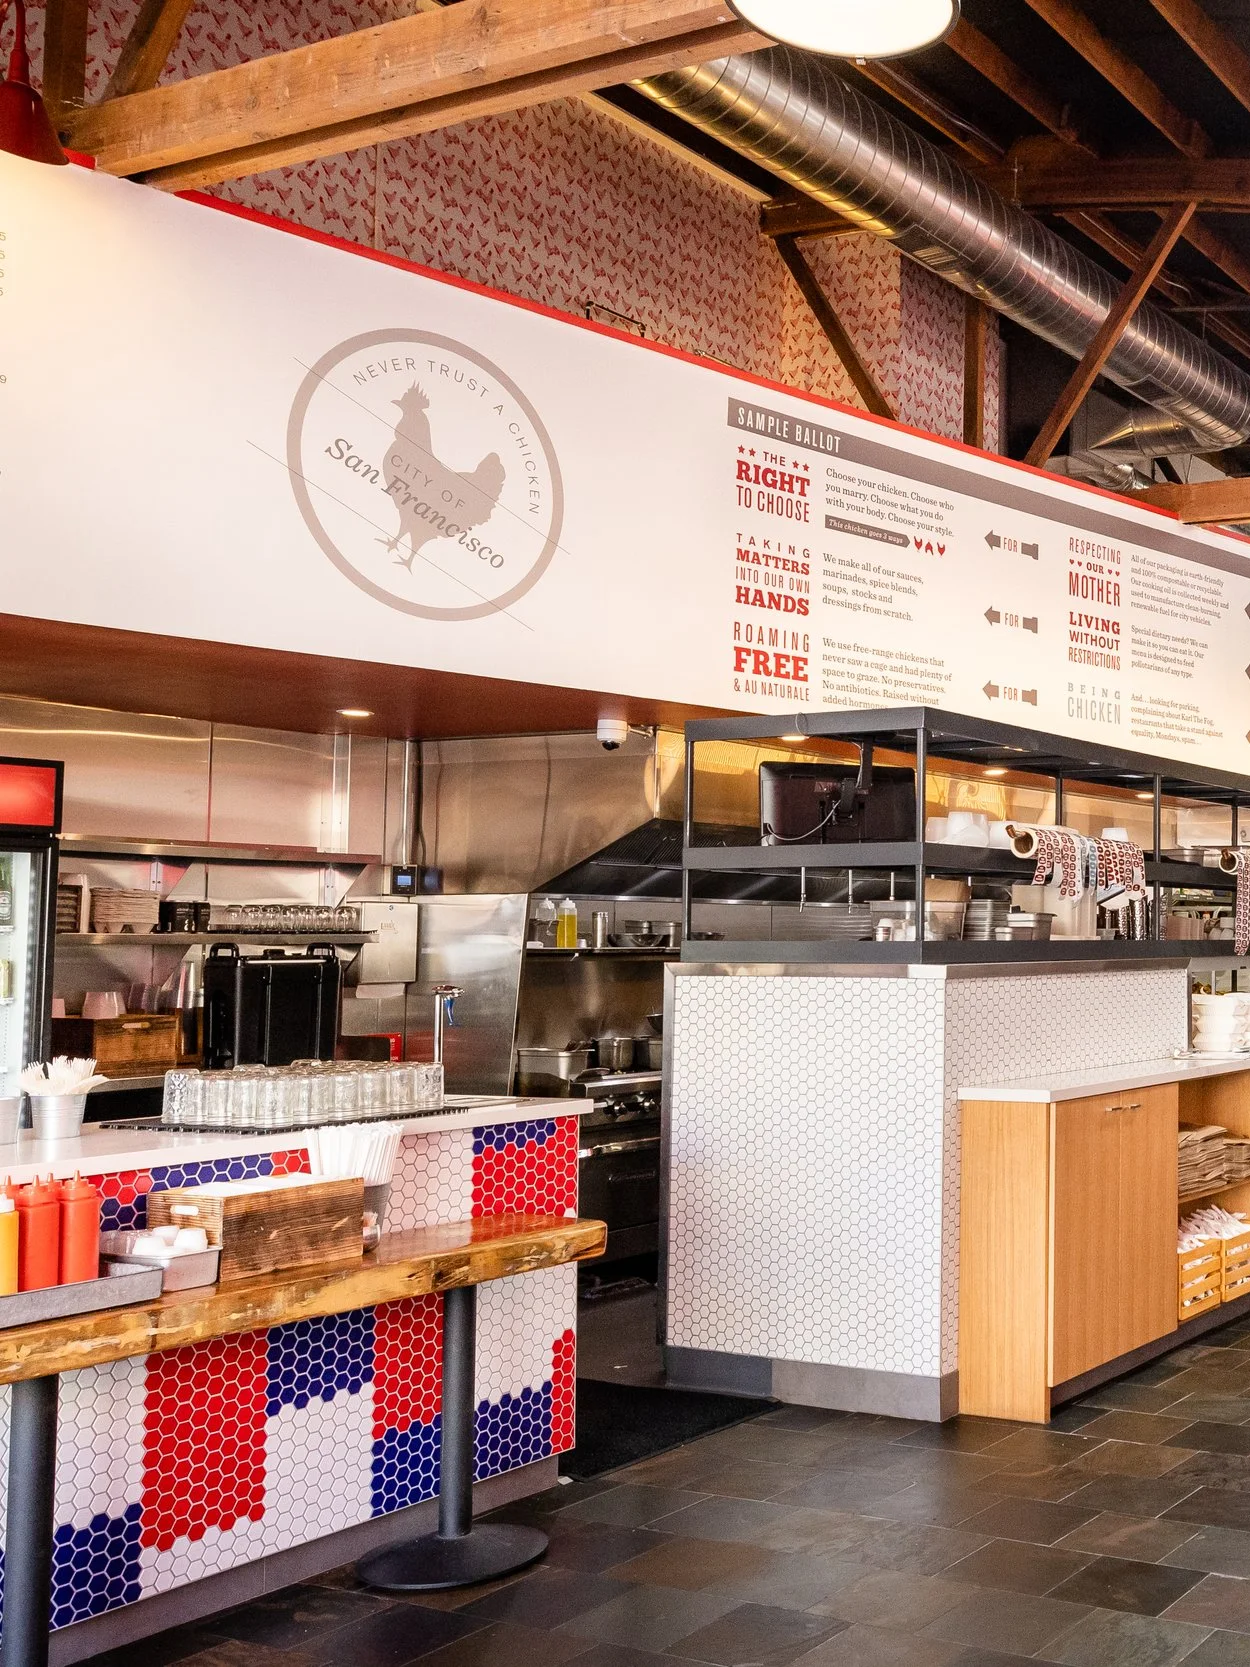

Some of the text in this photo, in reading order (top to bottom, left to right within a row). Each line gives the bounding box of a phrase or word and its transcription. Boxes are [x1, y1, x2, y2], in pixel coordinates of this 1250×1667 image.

[353, 357, 540, 514] NEVER TRUST A CHICKEN
[737, 407, 841, 453] SAMPLE BALLOT
[763, 451, 786, 467] THE
[391, 454, 466, 509] CITY OF
[736, 460, 810, 497] RIGHT
[826, 468, 954, 511] Choose your chicken. Choose who
[324, 438, 504, 568] San Francisco
[737, 486, 810, 523] TO CHOOSE
[825, 483, 943, 521] you marry. Choose what you do
[826, 497, 954, 537] with your body. Choose your style.
[829, 519, 843, 528] This
[844, 521, 868, 535] chicken
[869, 529, 882, 538] goes
[887, 535, 903, 543] ways
[736, 533, 810, 558] TAKING
[1003, 537, 1017, 553] FOR
[1069, 537, 1120, 564] RESPECTING
[736, 548, 810, 576] MATTERS
[823, 553, 923, 584] We make all of our sauces,
[1086, 562, 1104, 574] OUR
[1157, 563, 1183, 576] packaging
[736, 566, 810, 594] INTO OUR OWN
[823, 568, 918, 596] marinades, spice blends,
[823, 582, 892, 603] soups, stocks and
[1069, 571, 1120, 607] MOTHER
[1131, 577, 1141, 586] Our
[1142, 580, 1163, 593] cooking
[1177, 591, 1200, 601] collected
[1202, 597, 1219, 607] weekly
[735, 585, 809, 616] HANDS
[823, 595, 913, 621] dressings from scratch.
[1005, 613, 1019, 628] FOR
[1069, 611, 1120, 635] LIVING
[734, 621, 809, 652] ROAMING
[1069, 630, 1120, 651] WITHOUT
[734, 646, 808, 682] FREE
[823, 637, 944, 667] We use free-range chickens that
[1069, 647, 1120, 670] RESTRICTIONS
[822, 667, 845, 678] space
[857, 673, 879, 683] graze.
[882, 676, 892, 685] No
[894, 679, 946, 693] preservatives.
[823, 653, 846, 663] never
[847, 659, 863, 667] saw
[870, 662, 887, 672] cage
[889, 665, 903, 673] and
[905, 666, 918, 676] had
[920, 669, 943, 681] plenty
[944, 673, 952, 681] of
[734, 678, 809, 701] & AU NATURALE
[823, 680, 939, 705] No antibiotics. Raised without
[823, 695, 847, 706] added
[1004, 686, 1018, 701] FOR
[1068, 682, 1120, 699] BEING
[1068, 697, 1120, 724] CHICKEN
